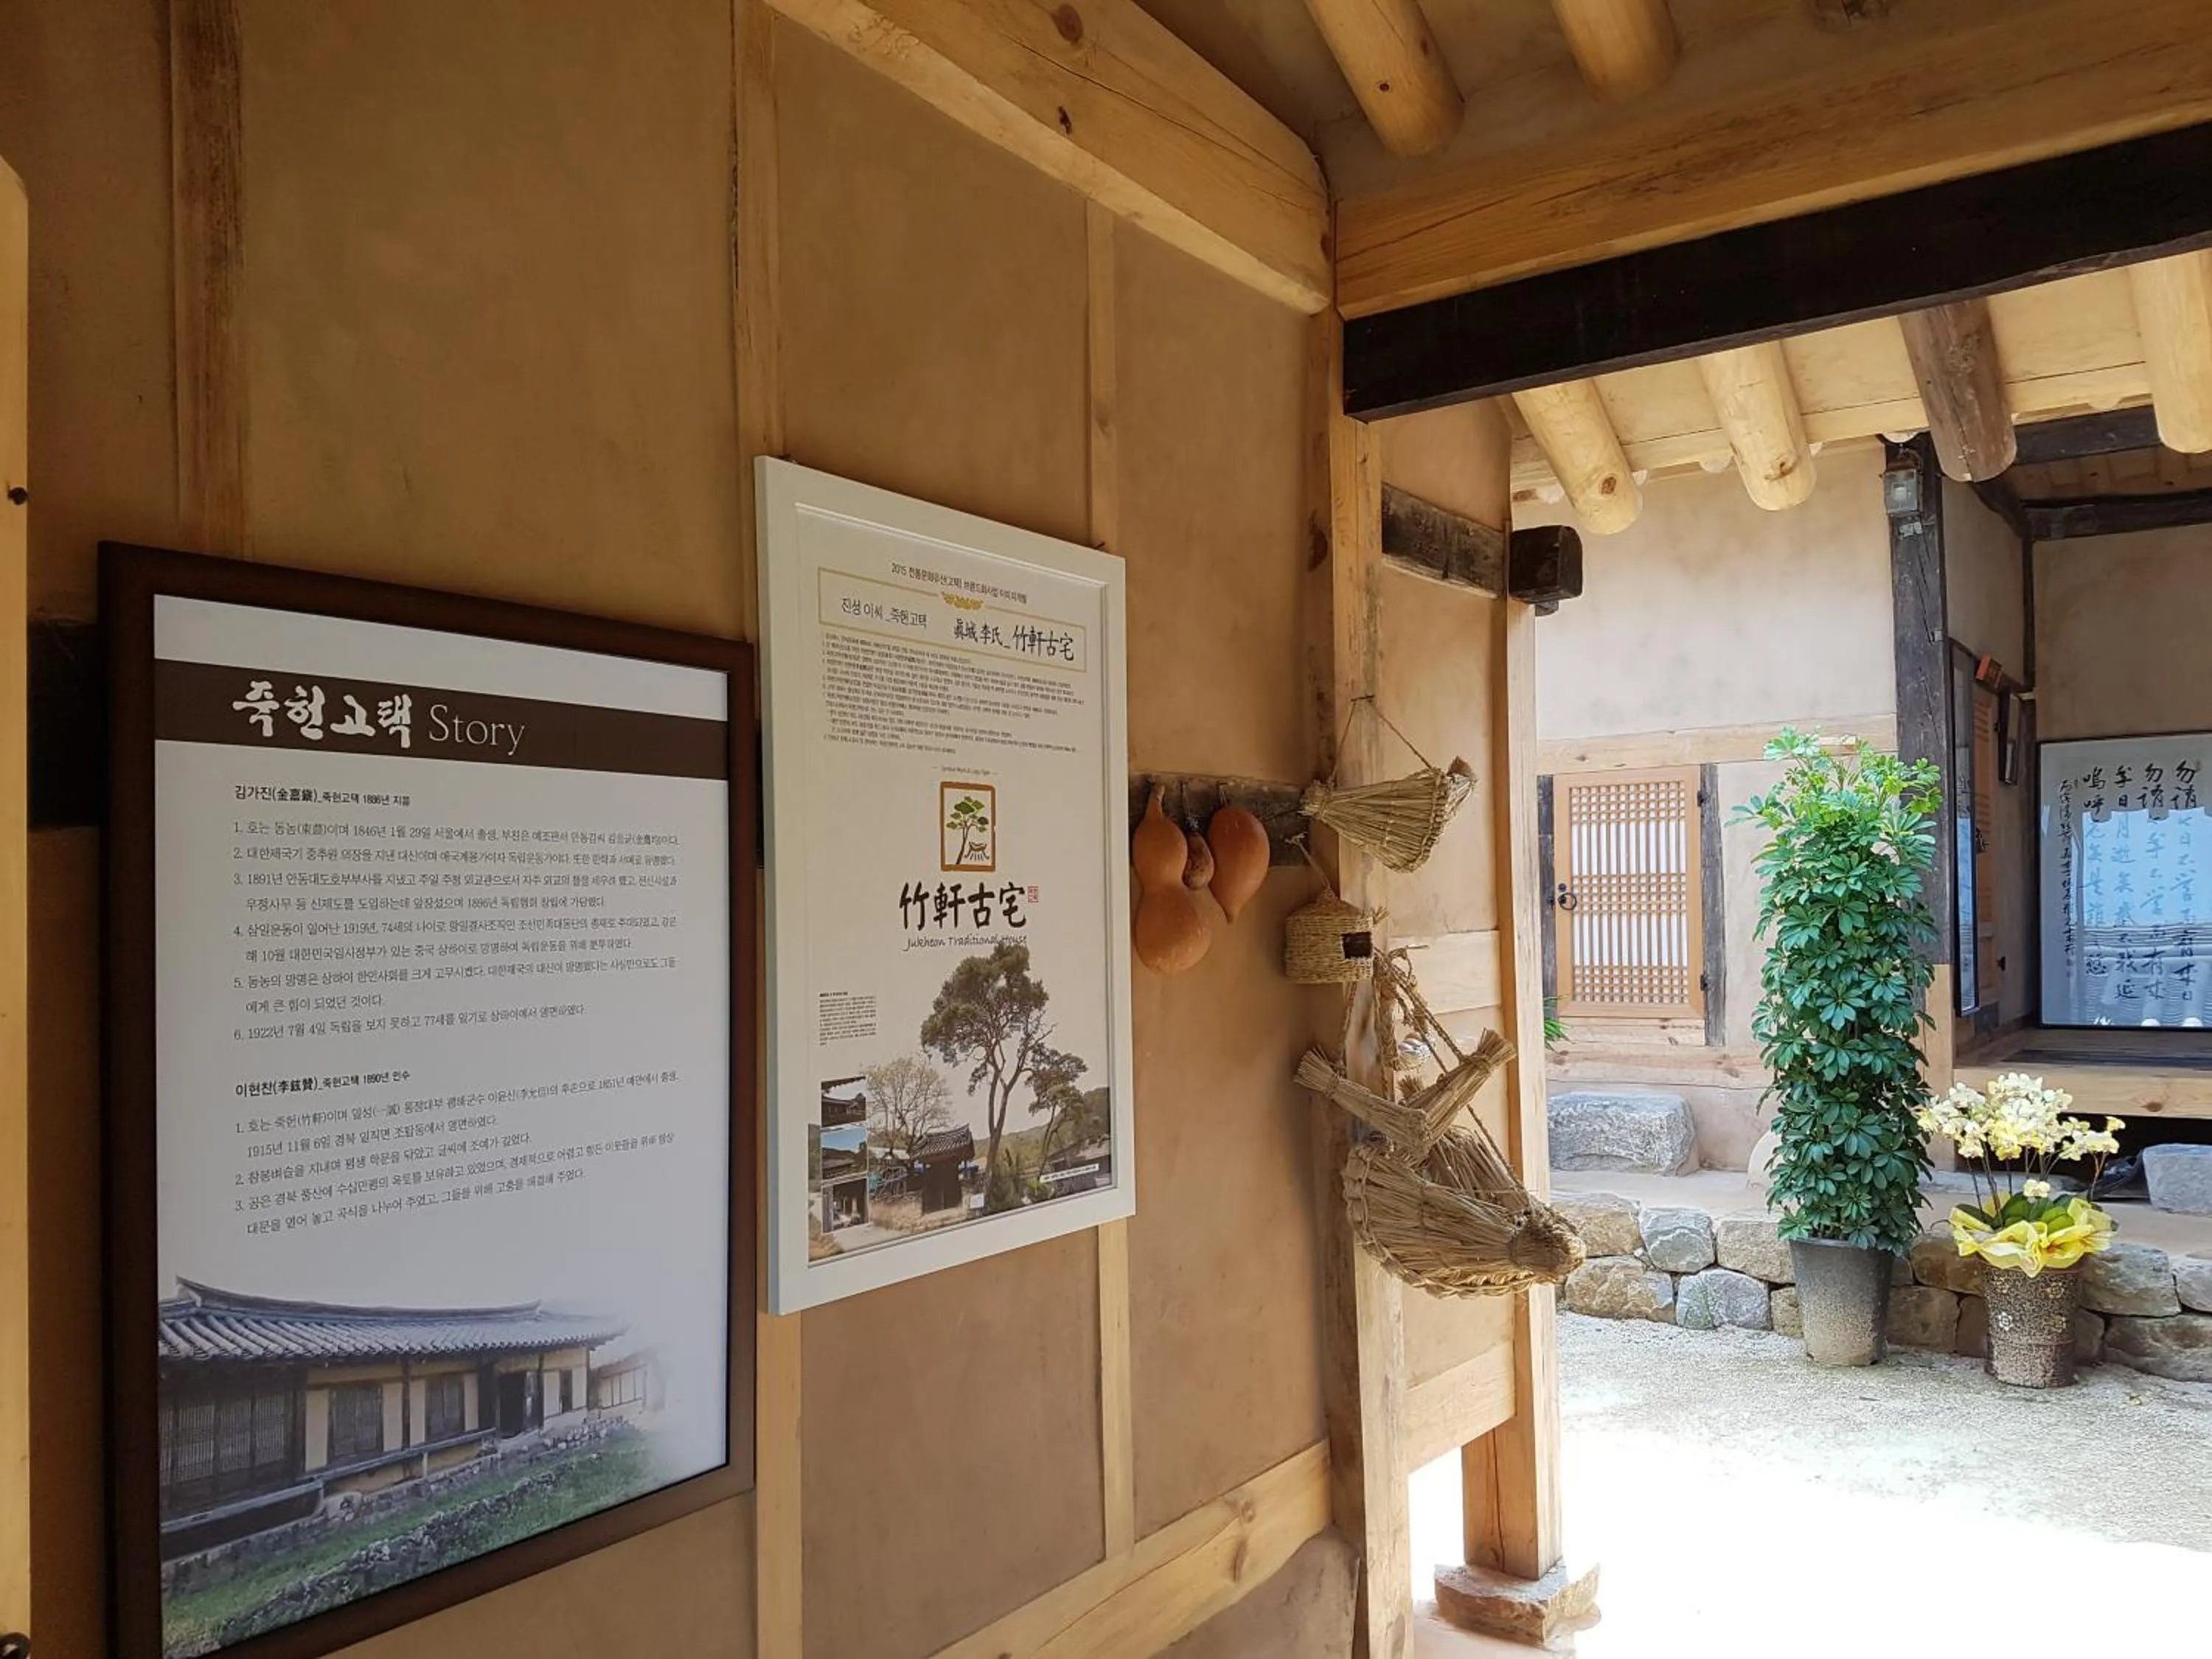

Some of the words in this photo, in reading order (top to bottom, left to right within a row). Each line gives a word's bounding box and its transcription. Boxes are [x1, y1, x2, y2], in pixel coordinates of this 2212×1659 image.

[841, 597, 861, 616] 진성
[232, 681, 412, 749] 죽헌고택
[428, 703, 525, 756] Story
[899, 881, 1027, 931] 竹軒古宅
[947, 932, 999, 947] Traditional
